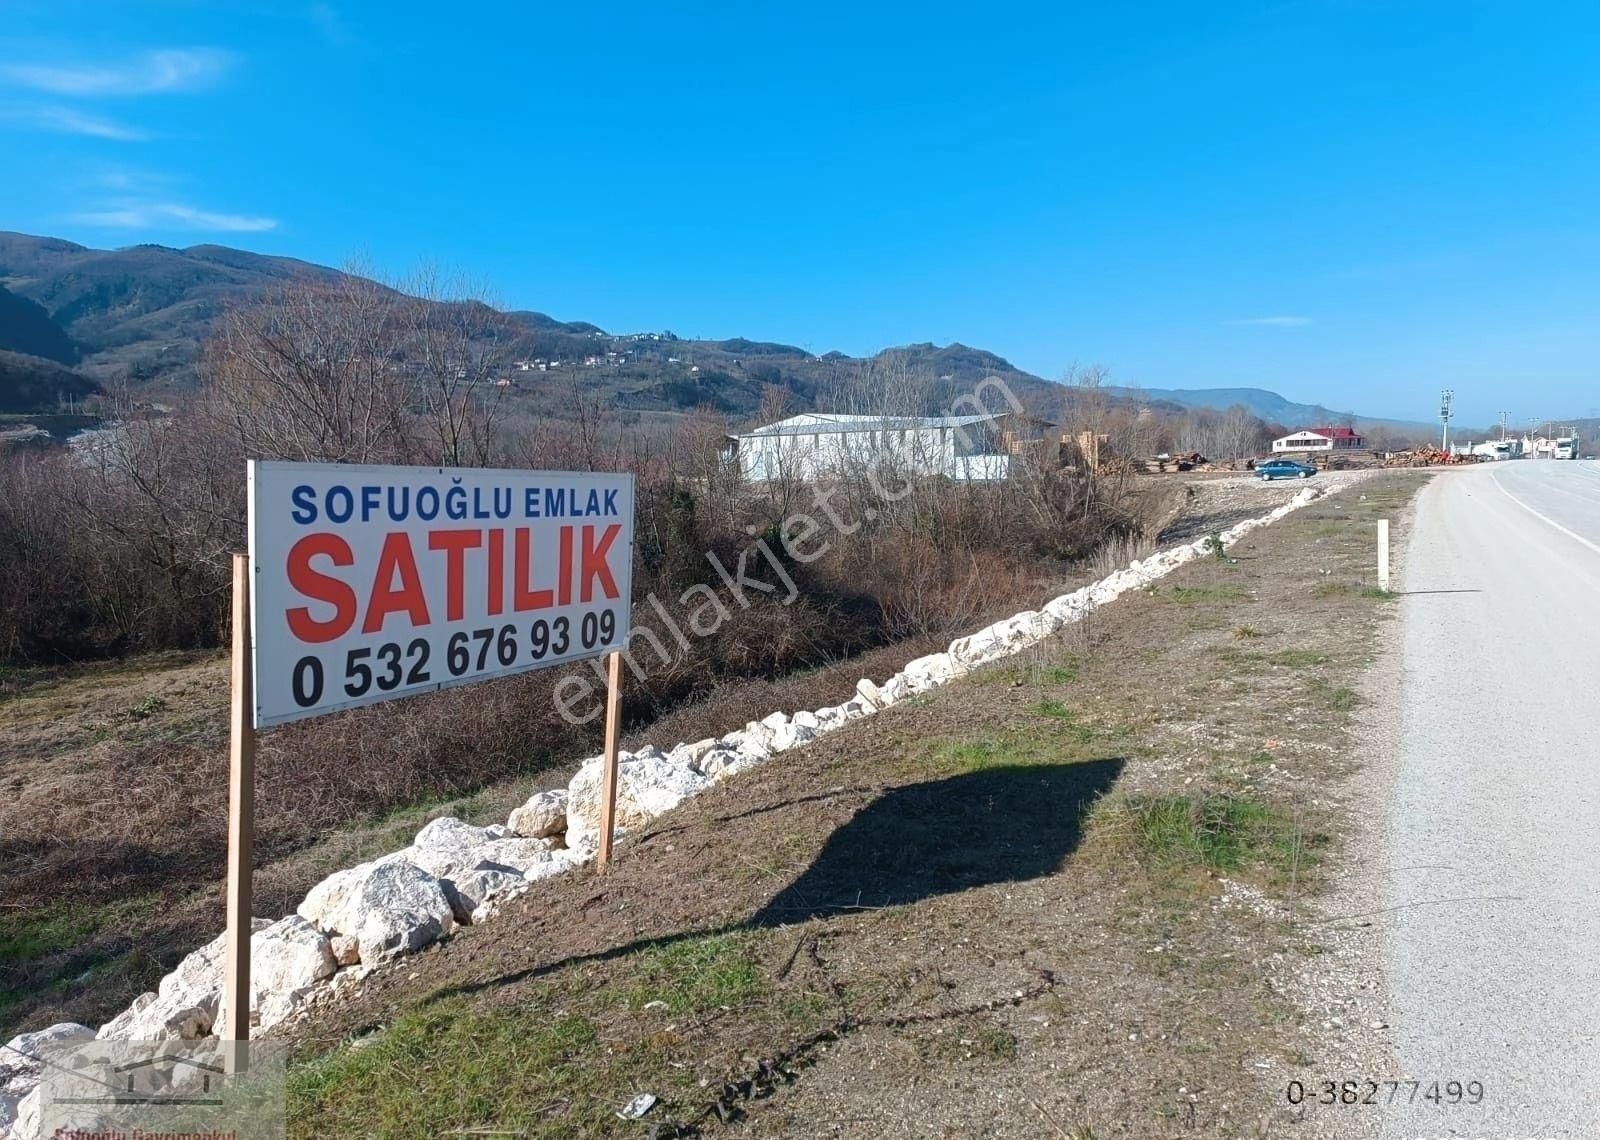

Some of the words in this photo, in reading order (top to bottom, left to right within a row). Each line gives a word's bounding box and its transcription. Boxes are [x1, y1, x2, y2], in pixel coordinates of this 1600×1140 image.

[291, 477, 512, 525] SOFUOĞLU
[524, 487, 618, 518] EMLAK
[285, 523, 623, 644] SATILIK
[292, 655, 324, 707] 0
[344, 637, 431, 698] 532
[447, 624, 519, 677] 676
[530, 616, 570, 660] 93
[581, 608, 616, 650] 09
